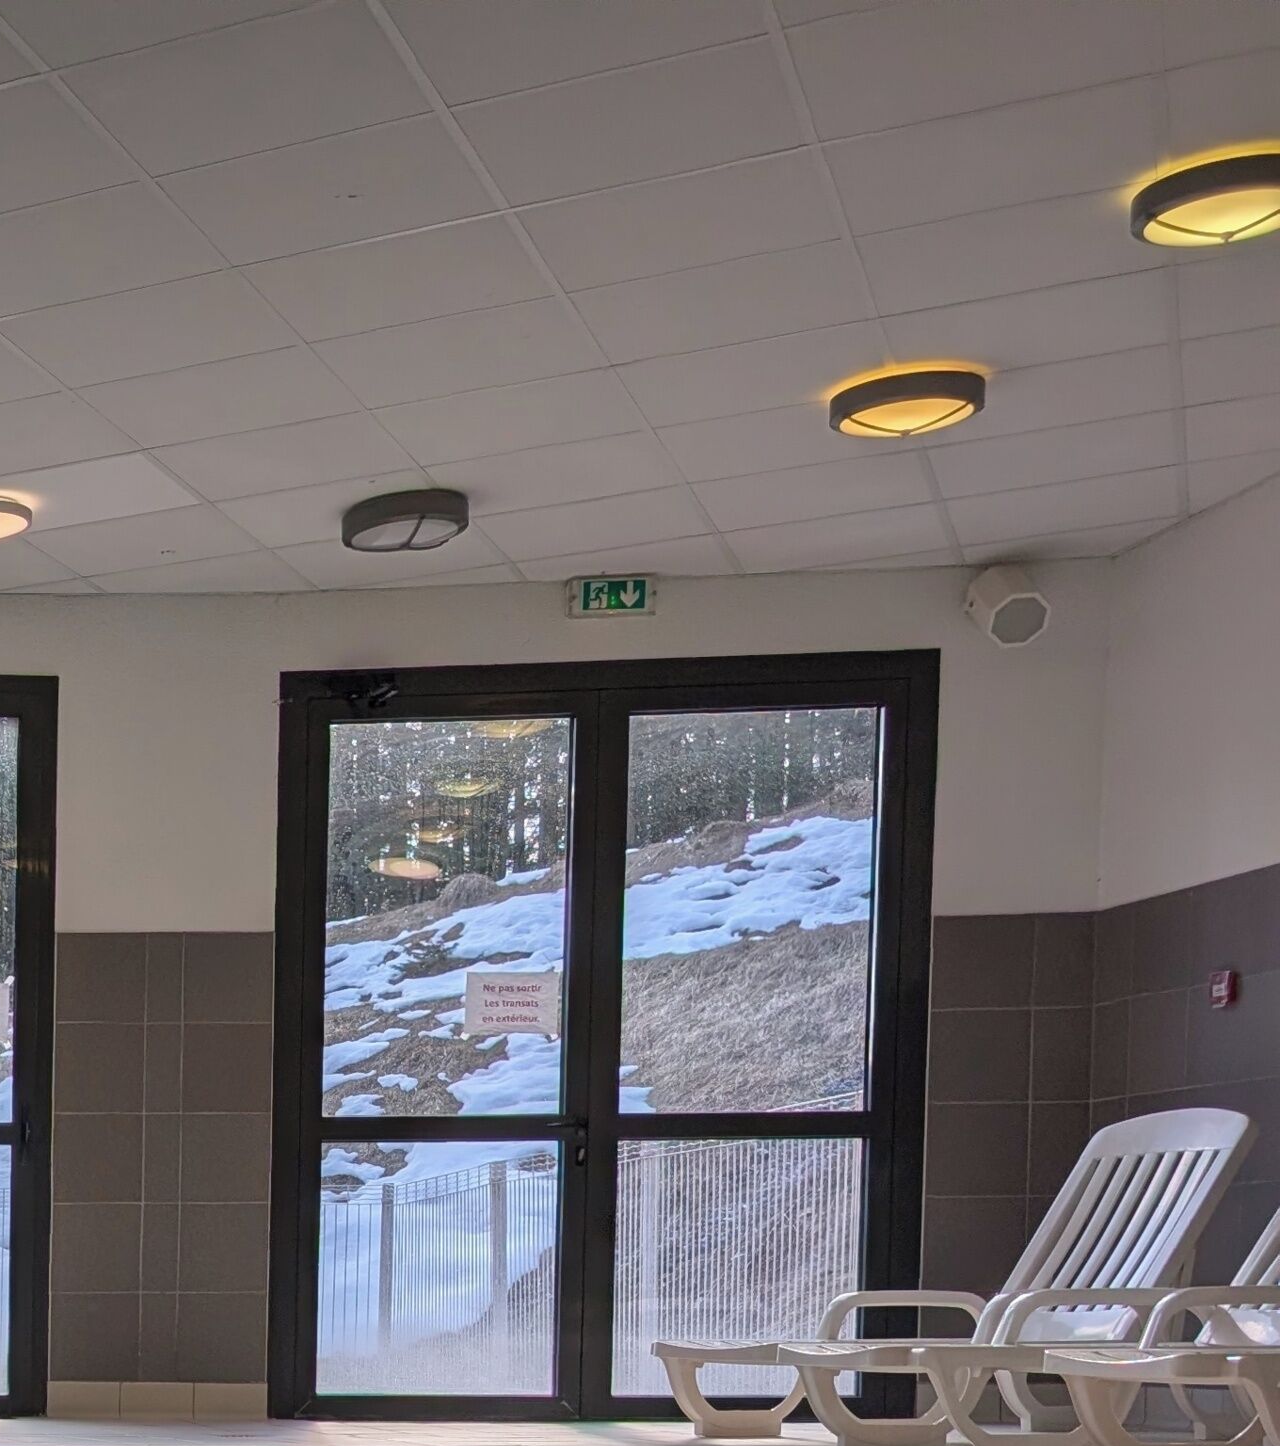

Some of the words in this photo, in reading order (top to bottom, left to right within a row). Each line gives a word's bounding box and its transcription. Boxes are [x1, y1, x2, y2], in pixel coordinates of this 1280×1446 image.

[482, 983, 496, 992] Ne
[498, 985, 515, 994] pas
[516, 983, 542, 992] sortir
[484, 999, 500, 1008] Les
[502, 999, 540, 1008] transats
[495, 1014, 541, 1023] extérieur.
